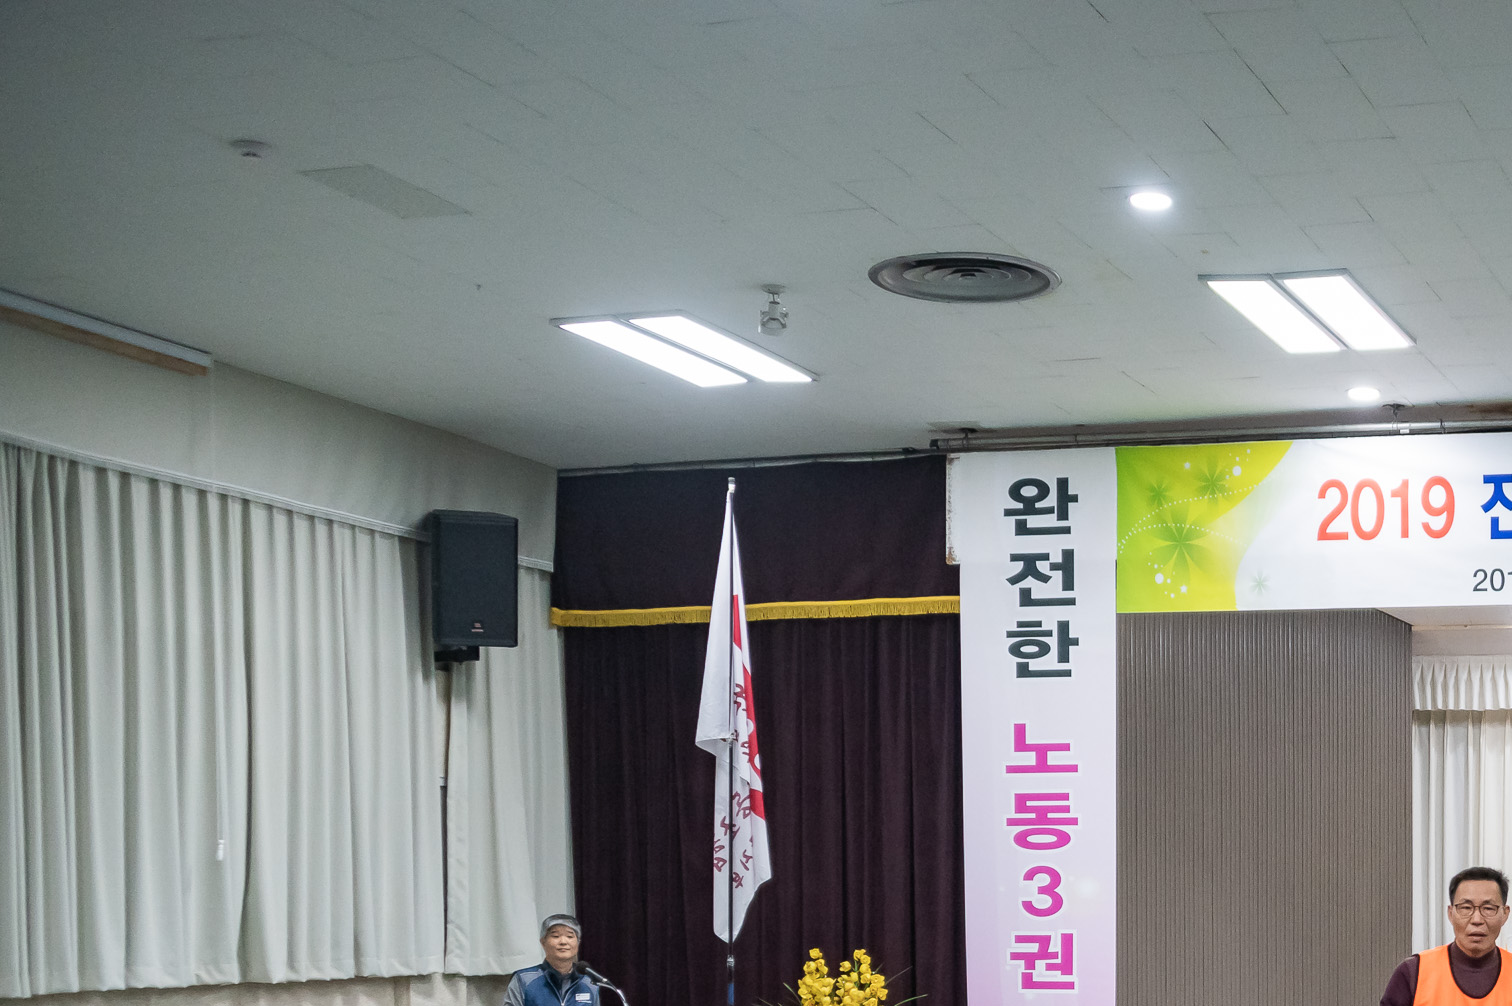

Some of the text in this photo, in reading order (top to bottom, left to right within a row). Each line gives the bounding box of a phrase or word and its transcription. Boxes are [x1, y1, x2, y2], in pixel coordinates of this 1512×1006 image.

[1003, 476, 1080, 679] 완전한
[1316, 475, 1456, 542] 2019
[1005, 722, 1079, 990] 노동3권
